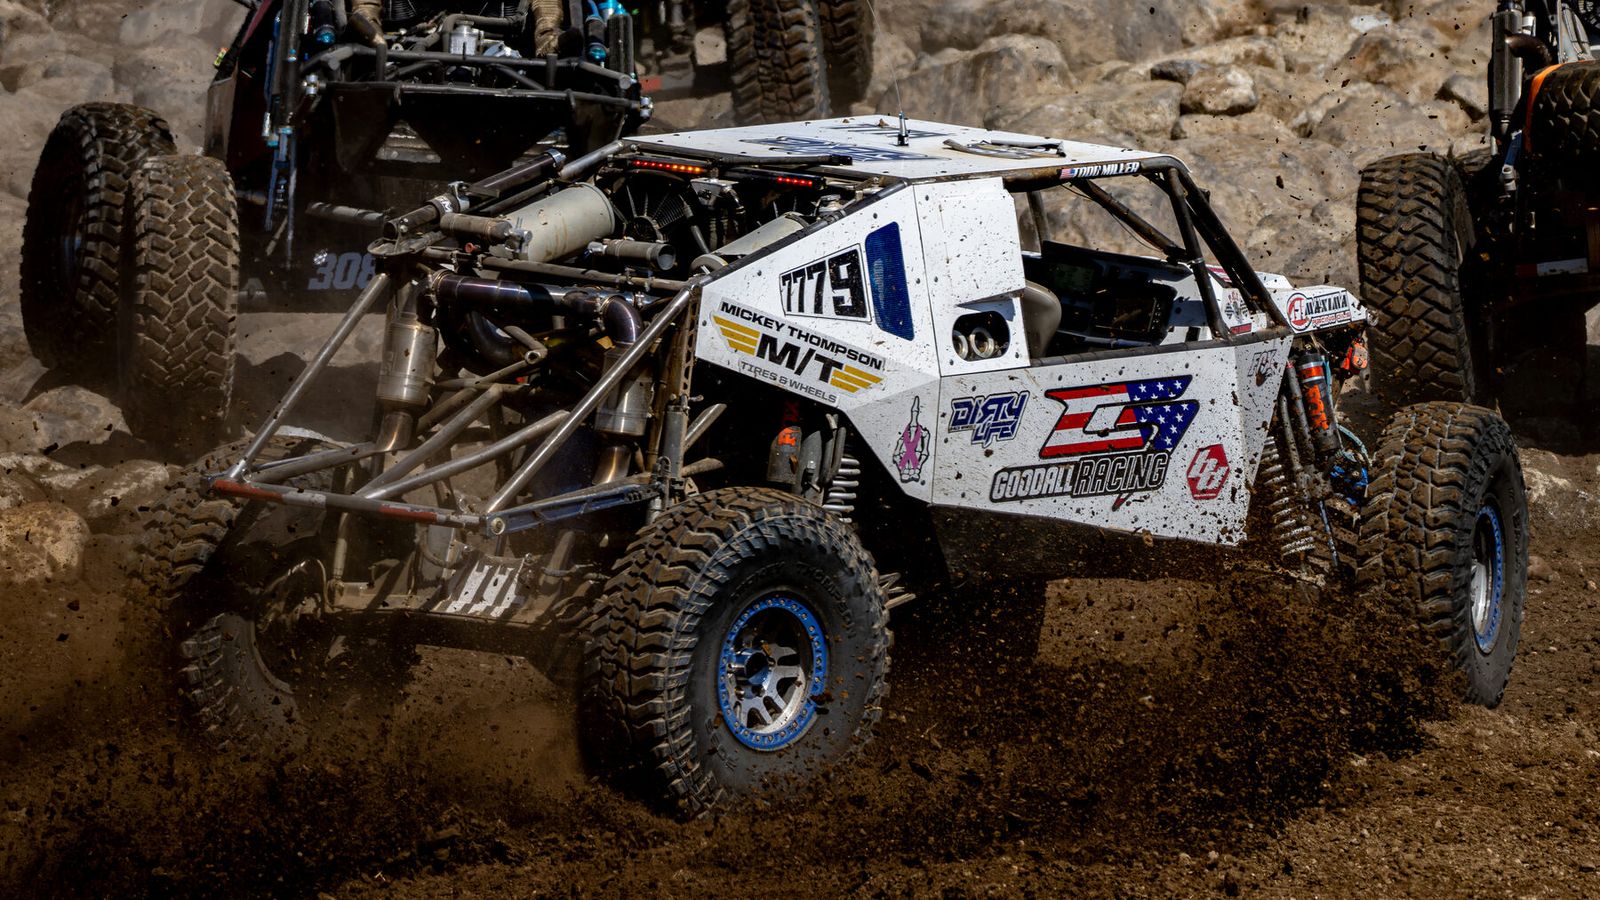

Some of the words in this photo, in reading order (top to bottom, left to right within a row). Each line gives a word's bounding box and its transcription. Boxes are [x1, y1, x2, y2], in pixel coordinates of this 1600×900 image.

[1101, 161, 1140, 176] MILLER
[781, 249, 868, 318] 7779
[1305, 294, 1348, 316] MAXIMA
[720, 301, 786, 332] MICKEY
[787, 325, 883, 370] THOMPSON
[755, 333, 845, 384] M/T
[741, 361, 778, 381] TIRES
[779, 375, 788, 385] &
[789, 379, 837, 403] WHEELS
[949, 391, 1029, 427] DIRTY
[972, 420, 1018, 447] LIFE
[992, 465, 1074, 500] GOODALL
[1072, 453, 1169, 496] RACING
